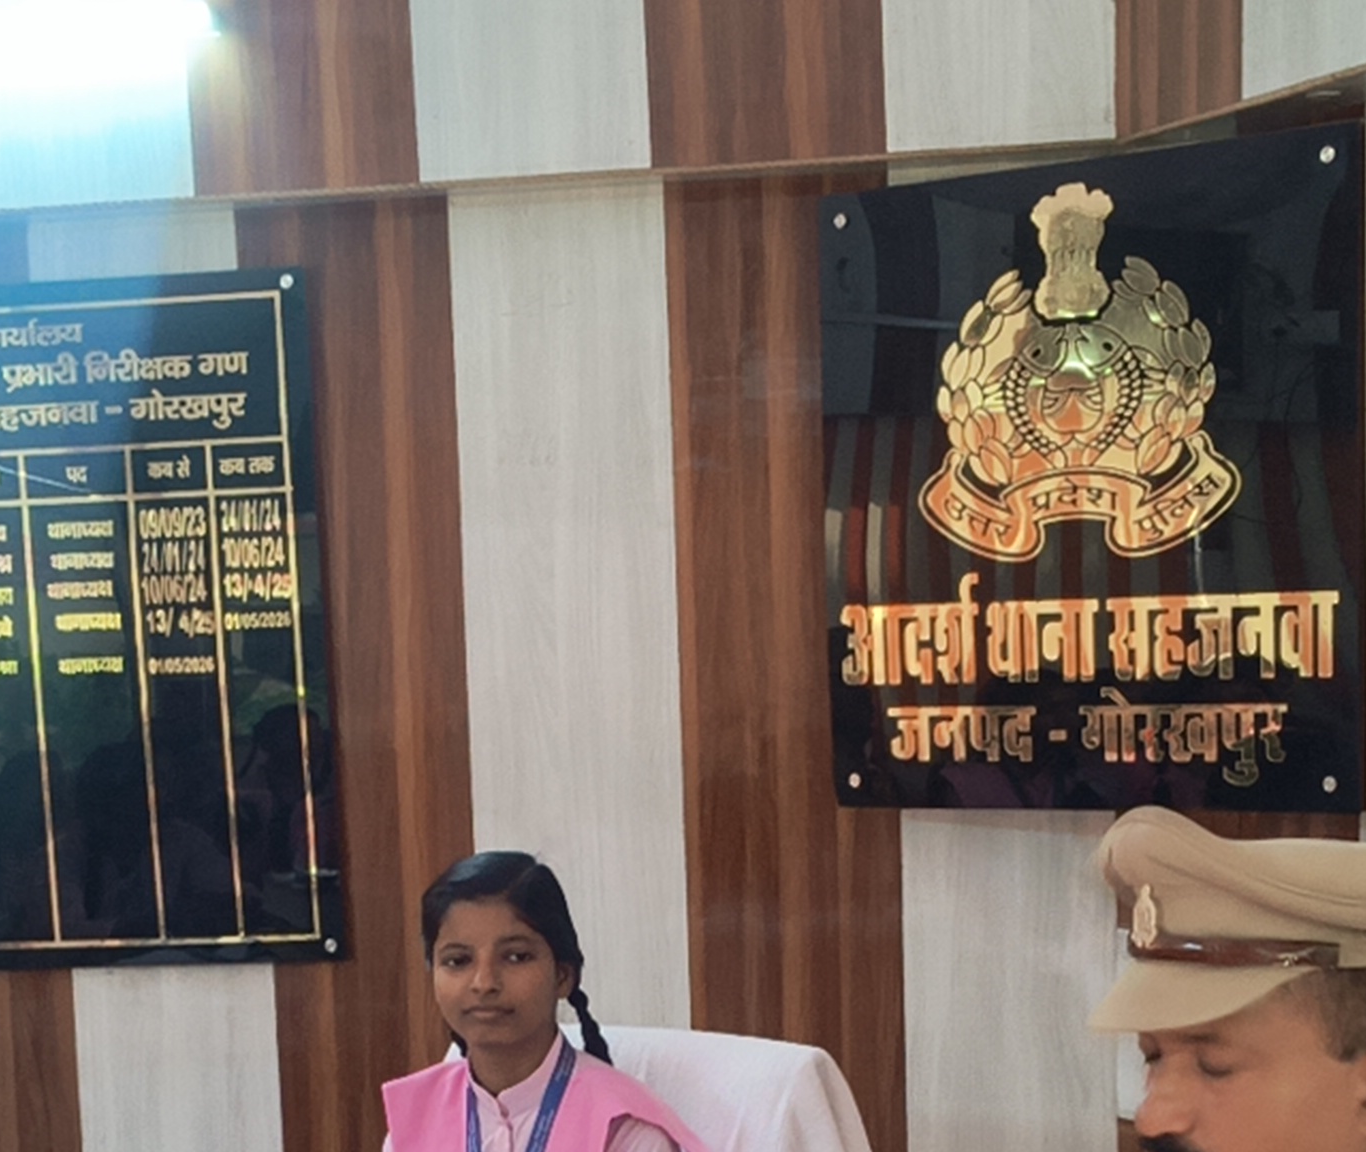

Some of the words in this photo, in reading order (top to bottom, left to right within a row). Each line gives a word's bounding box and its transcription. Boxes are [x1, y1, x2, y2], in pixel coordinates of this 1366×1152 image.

[2, 353, 79, 394] प्रभारी
[84, 348, 192, 383] निरीक्षक
[198, 351, 249, 376] गण
[129, 389, 247, 429] गोरखपुर
[65, 464, 88, 483] पद
[147, 460, 173, 479] कब
[176, 455, 191, 478] से
[218, 456, 245, 476] कब
[248, 455, 276, 475] तक
[139, 506, 207, 540] 09/09/23
[942, 492, 1012, 540] उत्तर
[1030, 476, 1118, 514] प्रदेश
[1134, 472, 1221, 543] पुलिस
[841, 572, 980, 686] आदर्श
[986, 598, 1100, 683] थाना
[1106, 590, 1340, 682] सहजनवा
[887, 704, 1037, 763] जनपद
[1048, 728, 1068, 742] -
[1079, 686, 1289, 786] गोरखपुर
